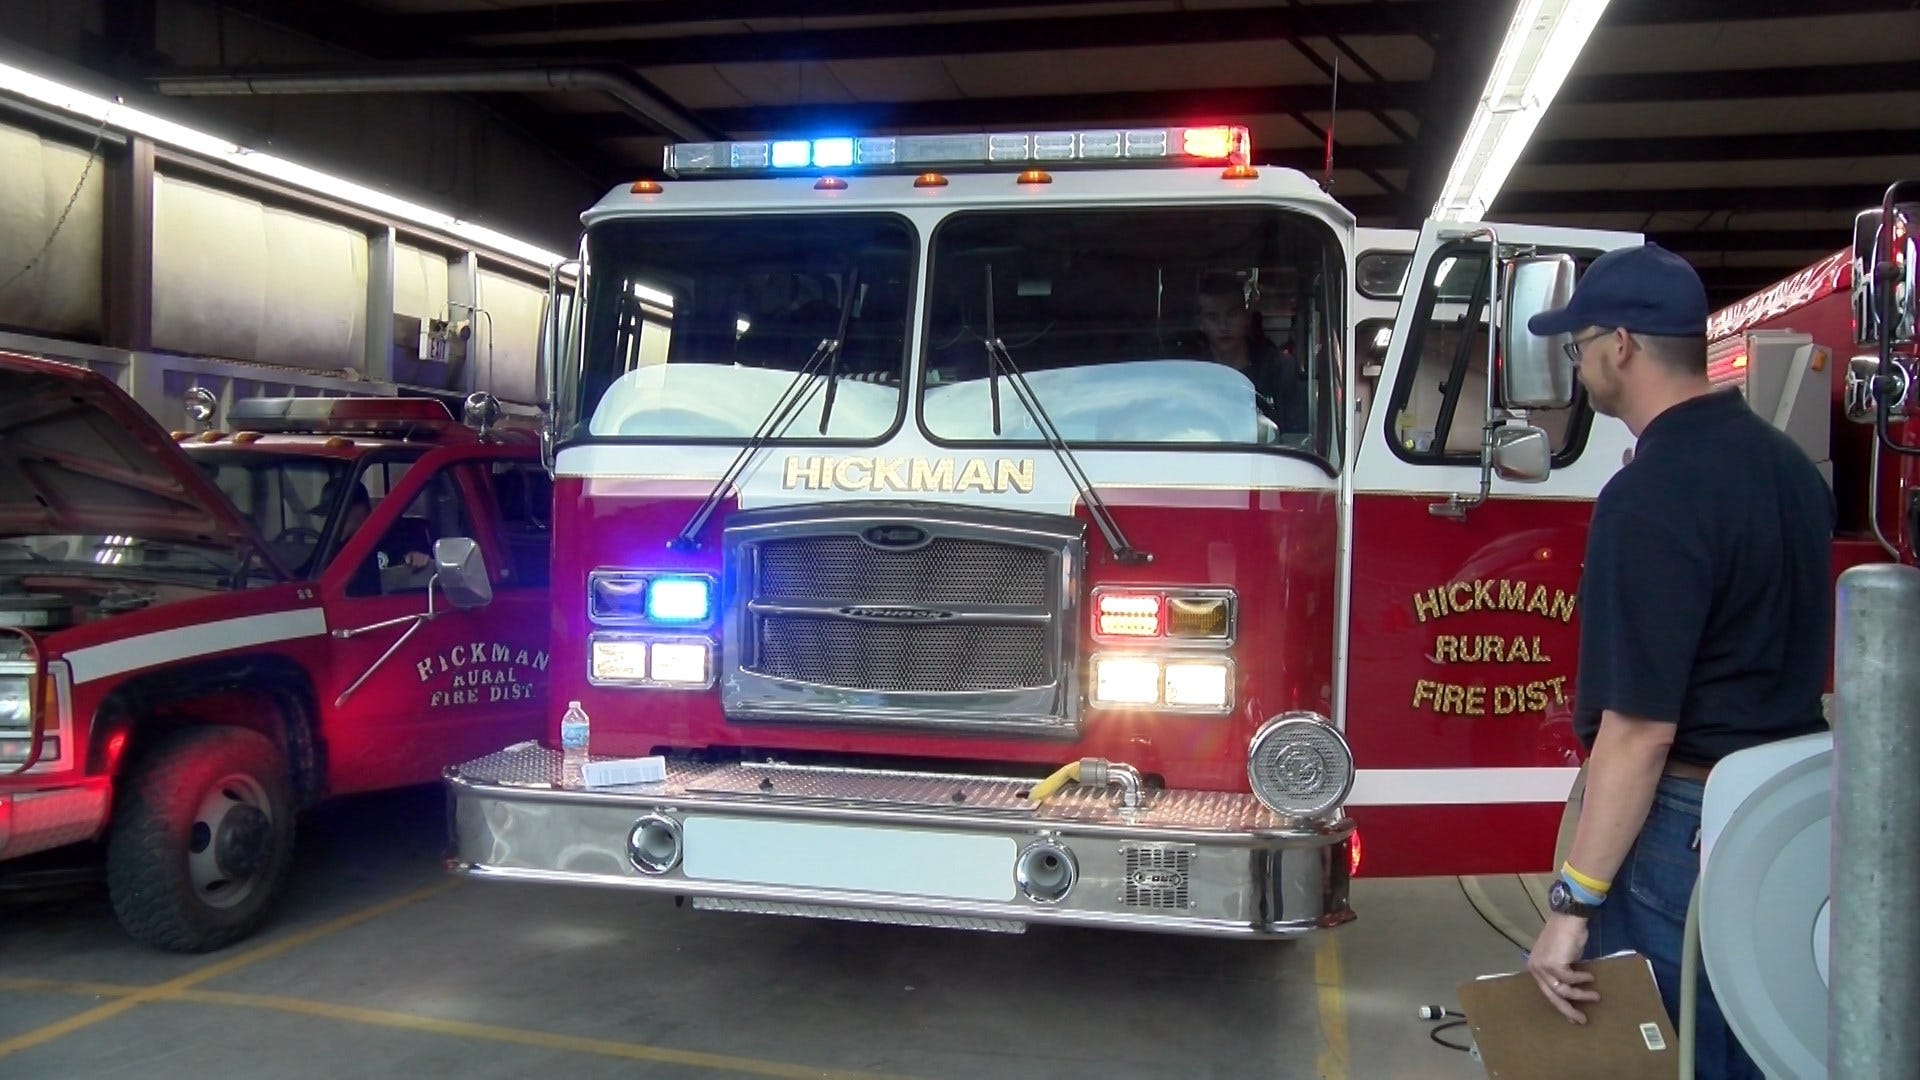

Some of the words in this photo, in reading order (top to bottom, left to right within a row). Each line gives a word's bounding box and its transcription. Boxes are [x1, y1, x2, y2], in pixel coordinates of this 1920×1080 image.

[430, 337, 448, 359] EXIT
[782, 455, 1034, 494] HICKMAN
[1413, 579, 1577, 623] HICKMAN
[416, 643, 549, 681] HICKMAN
[1435, 635, 1551, 662] RURAL
[453, 667, 517, 687] RURAL
[430, 689, 479, 706] FIRE
[1412, 679, 1486, 714] FIRE
